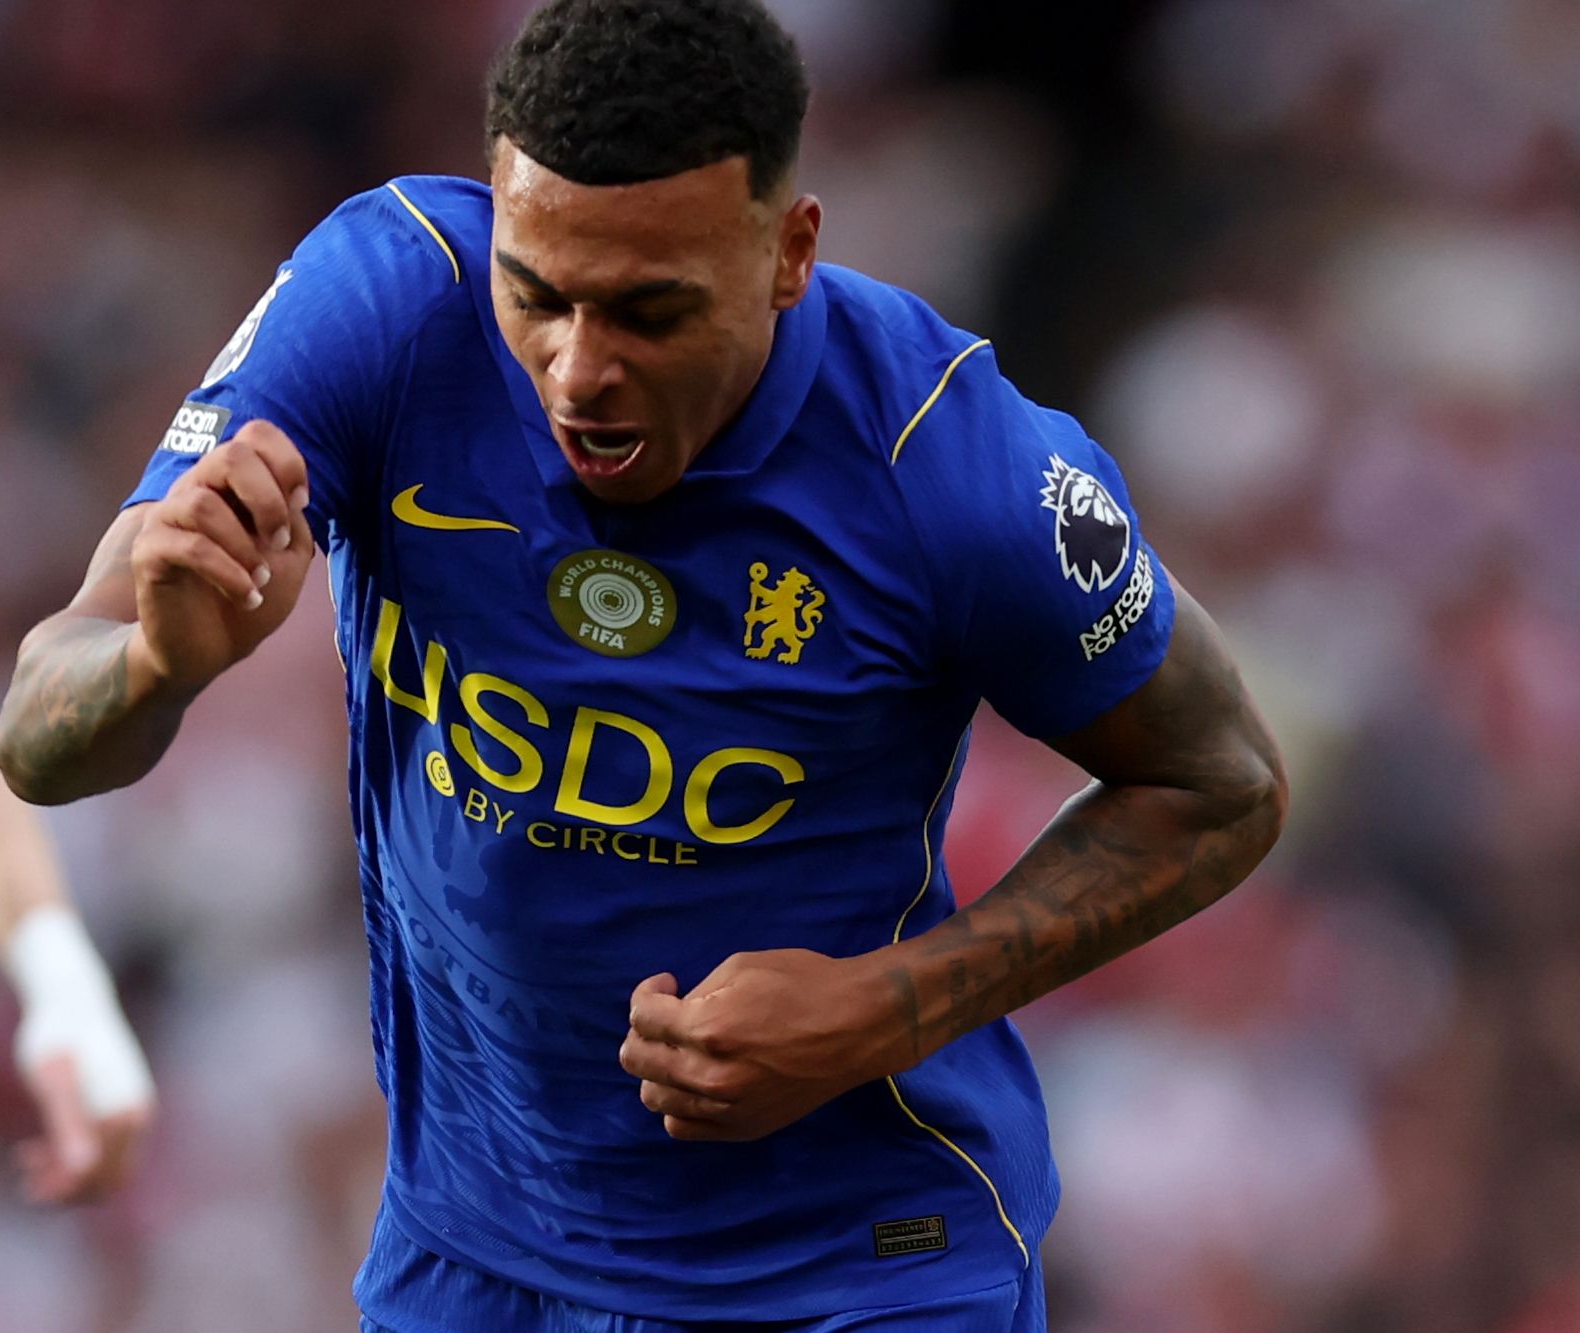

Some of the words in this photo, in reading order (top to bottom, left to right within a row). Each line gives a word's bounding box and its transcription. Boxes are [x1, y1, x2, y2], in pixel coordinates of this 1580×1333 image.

[559, 559, 596, 597] WORLD
[600, 558, 665, 627] CHAMPIONS
[579, 621, 625, 650] FIFA
[1079, 614, 1114, 650] No
[370, 596, 806, 845] USDC
[463, 786, 515, 835] BY
[526, 821, 699, 866] CIRCLE
